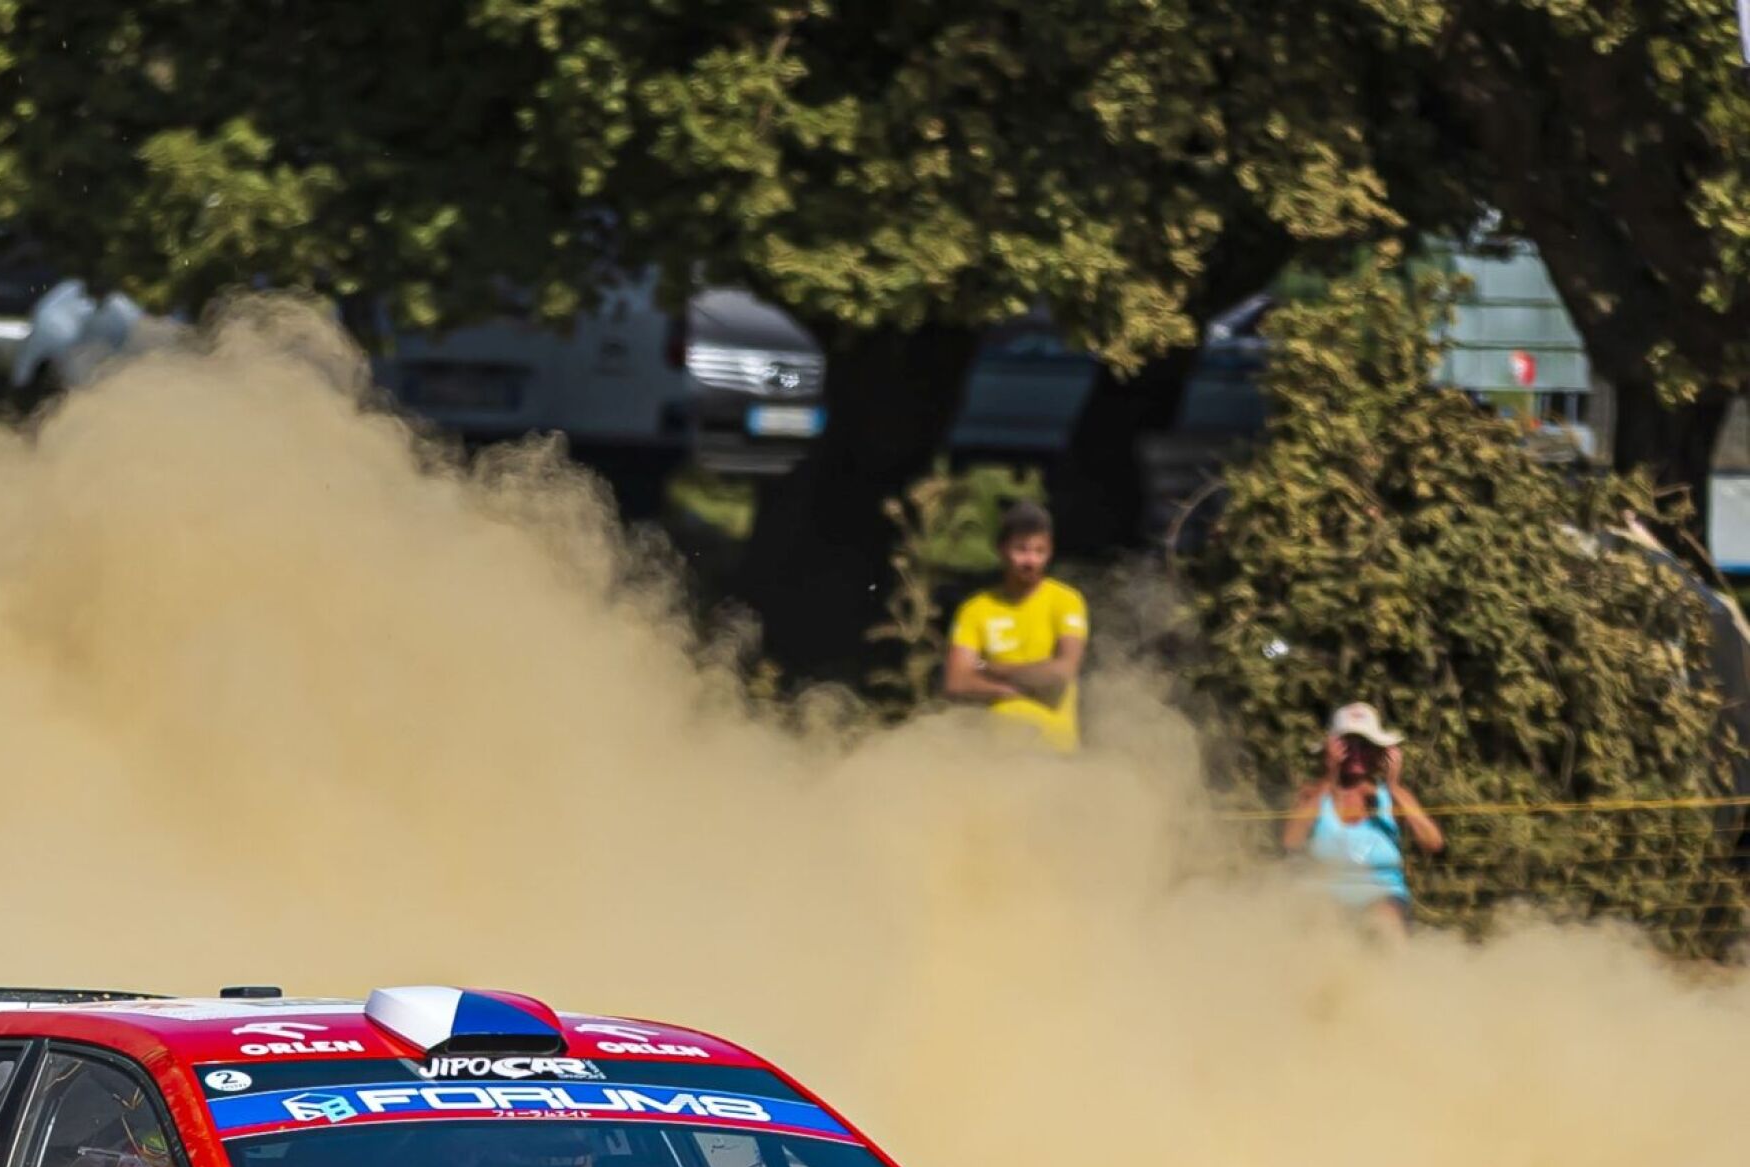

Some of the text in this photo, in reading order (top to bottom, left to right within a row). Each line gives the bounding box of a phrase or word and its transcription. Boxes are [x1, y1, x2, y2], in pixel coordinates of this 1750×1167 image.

[239, 1039, 366, 1055] ORLEN
[597, 1041, 710, 1058] ORLEN
[418, 1057, 592, 1079] JIPOCAR
[216, 1072, 238, 1084] 2
[356, 1086, 772, 1122] FORUM8
